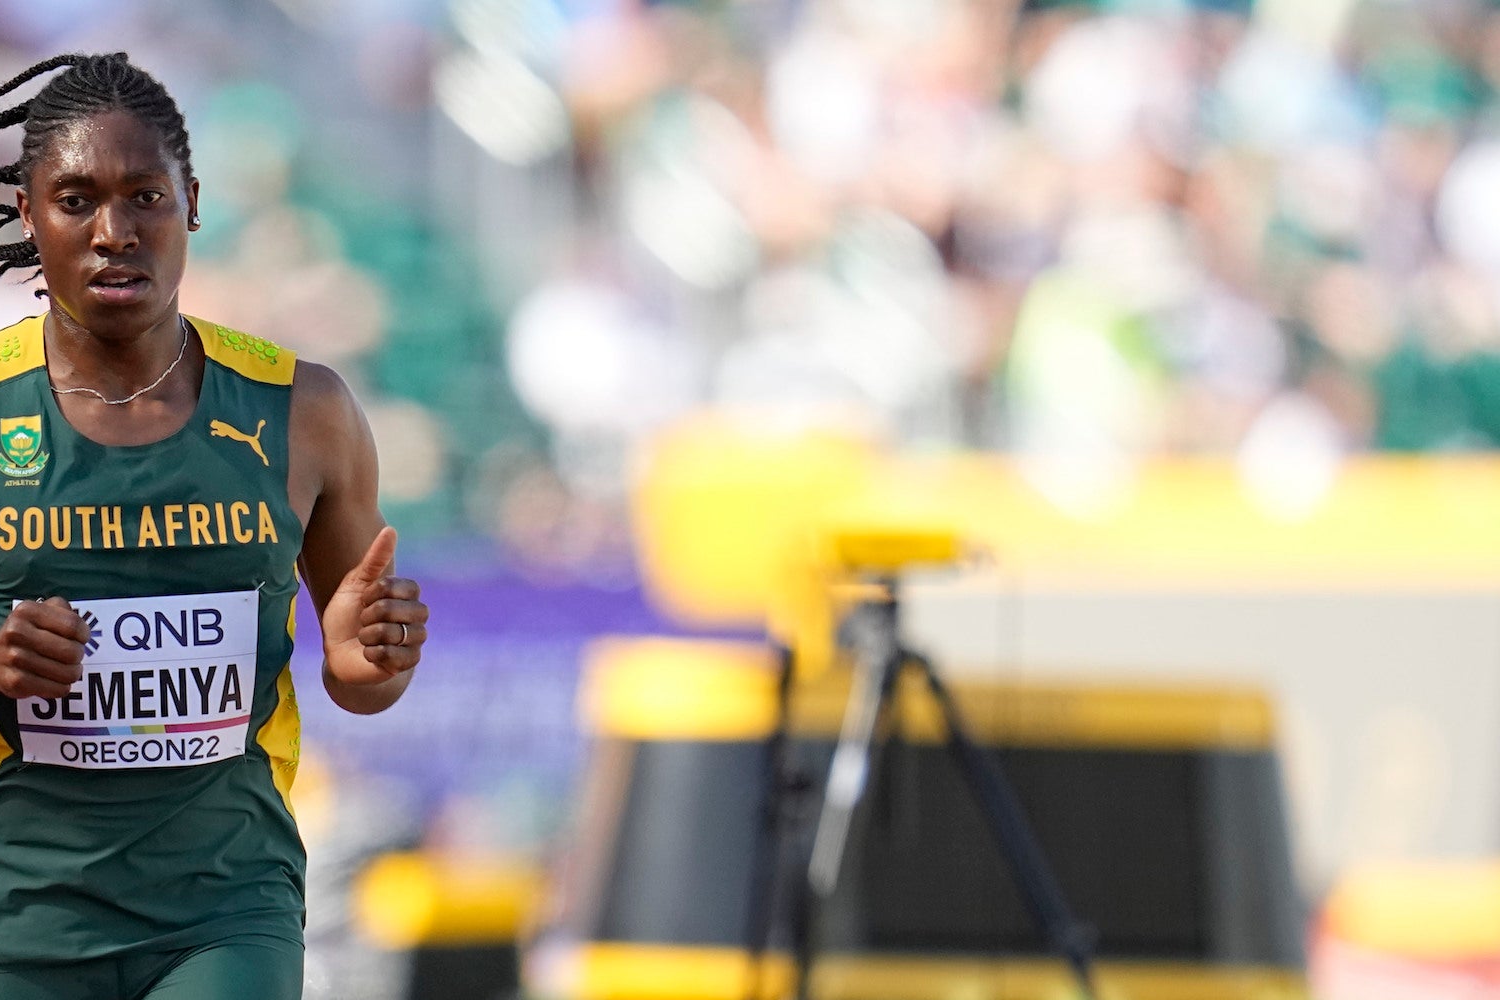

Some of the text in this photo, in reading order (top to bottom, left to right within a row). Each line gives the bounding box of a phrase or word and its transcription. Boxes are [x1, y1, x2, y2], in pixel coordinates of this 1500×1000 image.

[4, 479, 40, 487] ATHLETICS
[138, 501, 279, 547] AFRICA
[114, 608, 224, 651] QNB
[60, 735, 220, 763] OREGON22
